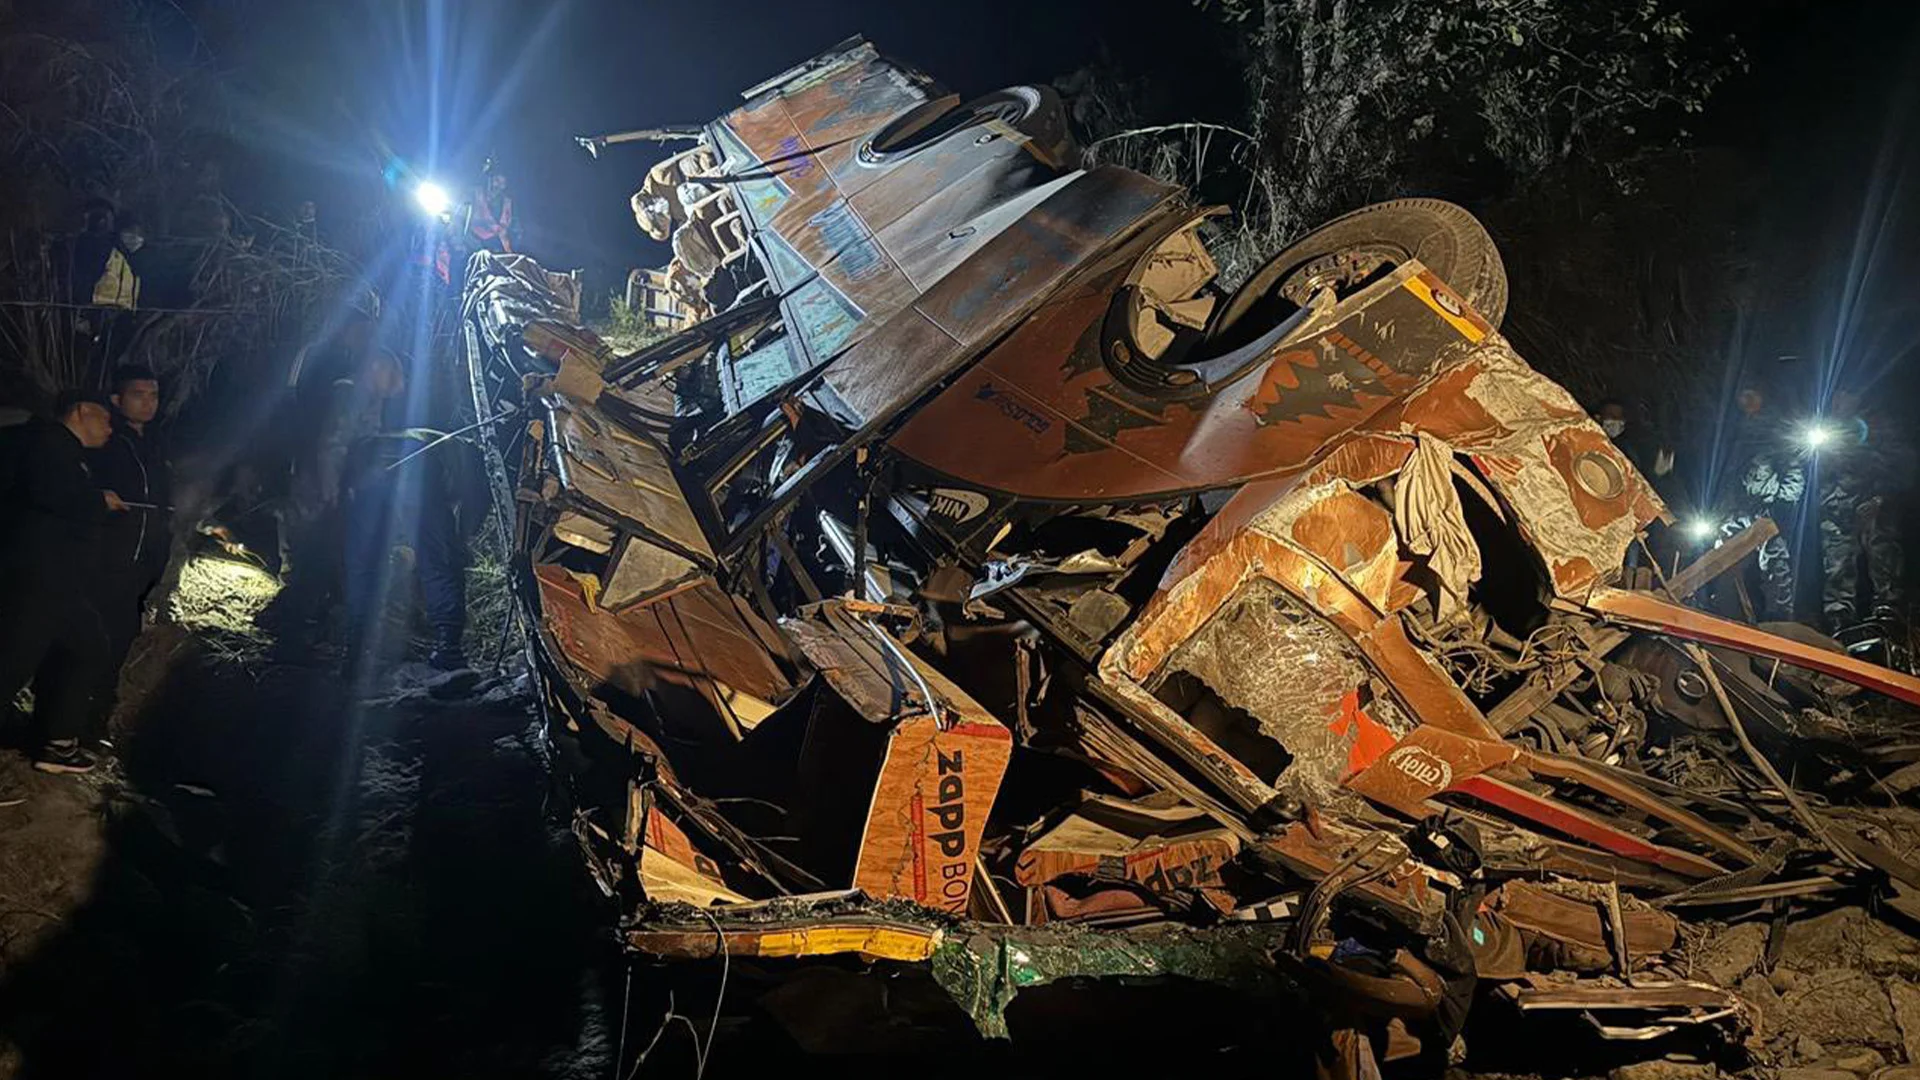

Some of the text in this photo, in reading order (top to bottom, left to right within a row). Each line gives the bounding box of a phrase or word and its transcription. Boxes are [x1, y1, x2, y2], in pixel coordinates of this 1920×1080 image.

[932, 495, 967, 520] NIK
[1397, 756, 1441, 786] लाभ
[927, 750, 965, 858] zapp
[1132, 853, 1217, 895] zap
